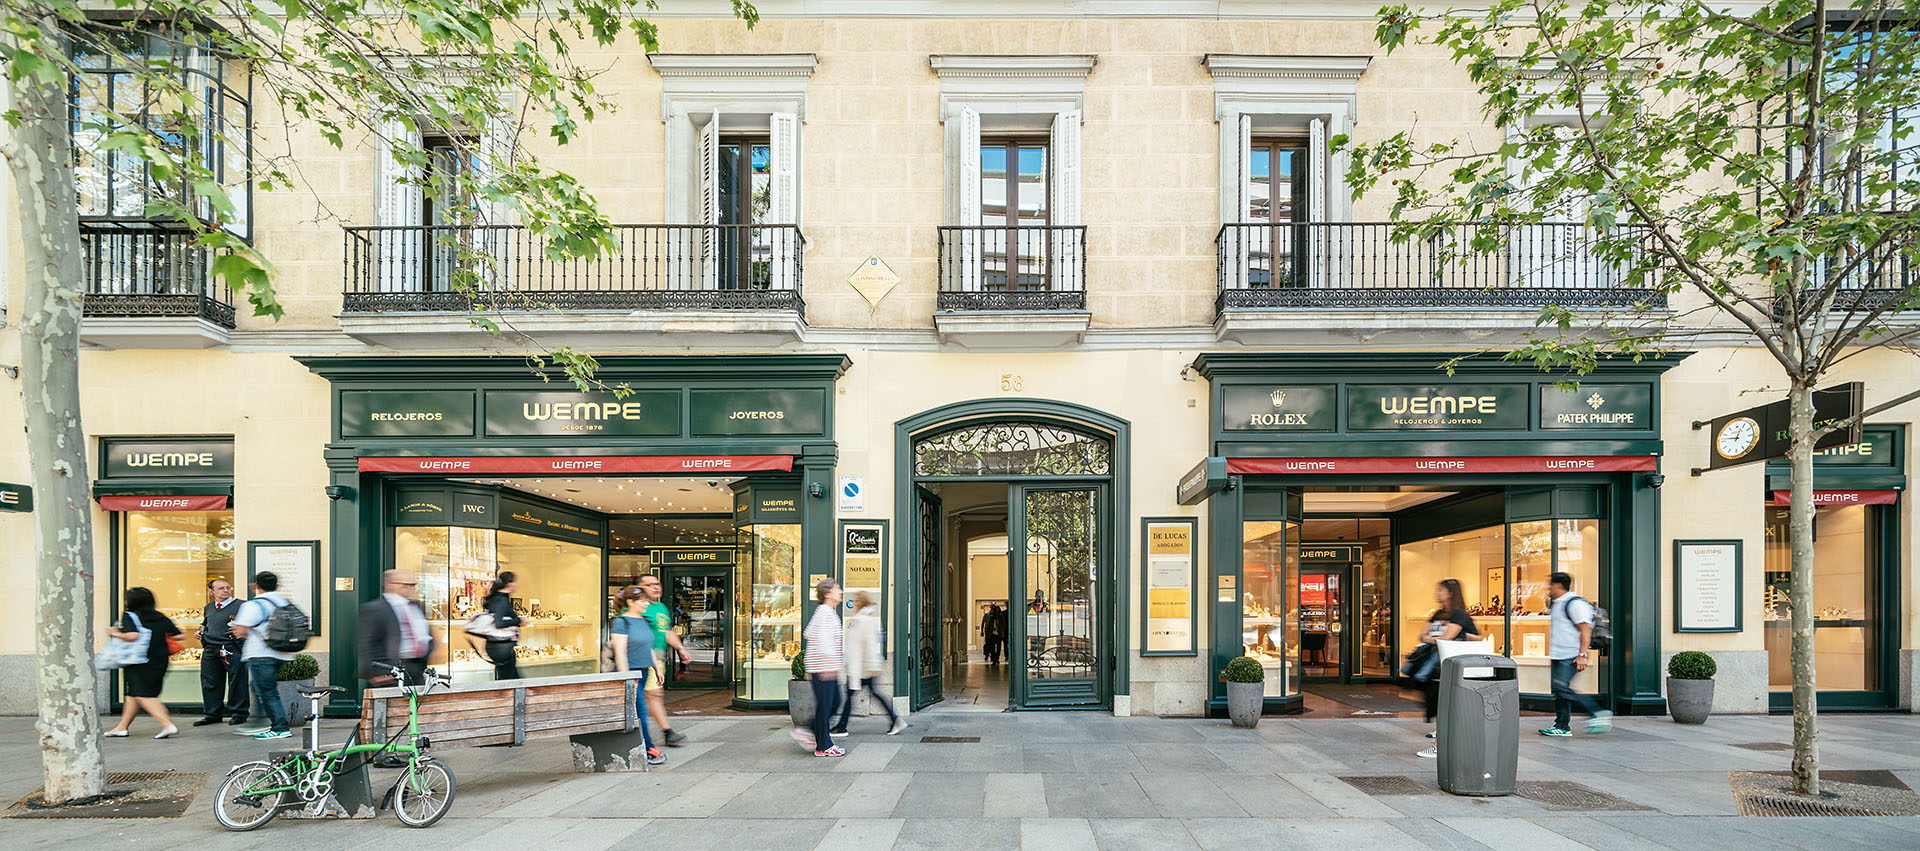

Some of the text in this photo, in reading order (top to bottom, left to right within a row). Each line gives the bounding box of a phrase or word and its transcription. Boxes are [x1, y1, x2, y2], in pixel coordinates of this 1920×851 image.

[1001, 373, 1024, 392] 58
[1381, 396, 1496, 414] WEMPE
[523, 402, 640, 420] WEMPE
[729, 411, 784, 420] JOYEROS
[371, 412, 442, 421] RELOJEROS
[1250, 413, 1308, 425] ROLEX
[1557, 413, 1634, 424] PATEK PHILIPPE
[127, 453, 213, 467] WEMPE
[682, 459, 732, 468] WEMPE
[1546, 460, 1594, 468] WEMPE
[420, 461, 471, 469] WEMPE
[552, 461, 602, 469] WEMPE
[1286, 461, 1335, 470] WEMPE
[1415, 461, 1465, 469] WEMPE
[1812, 493, 1858, 502] WEMPE
[140, 499, 189, 507] WEMPE
[462, 504, 485, 514] IWC
[1300, 550, 1336, 558] WEMPE
